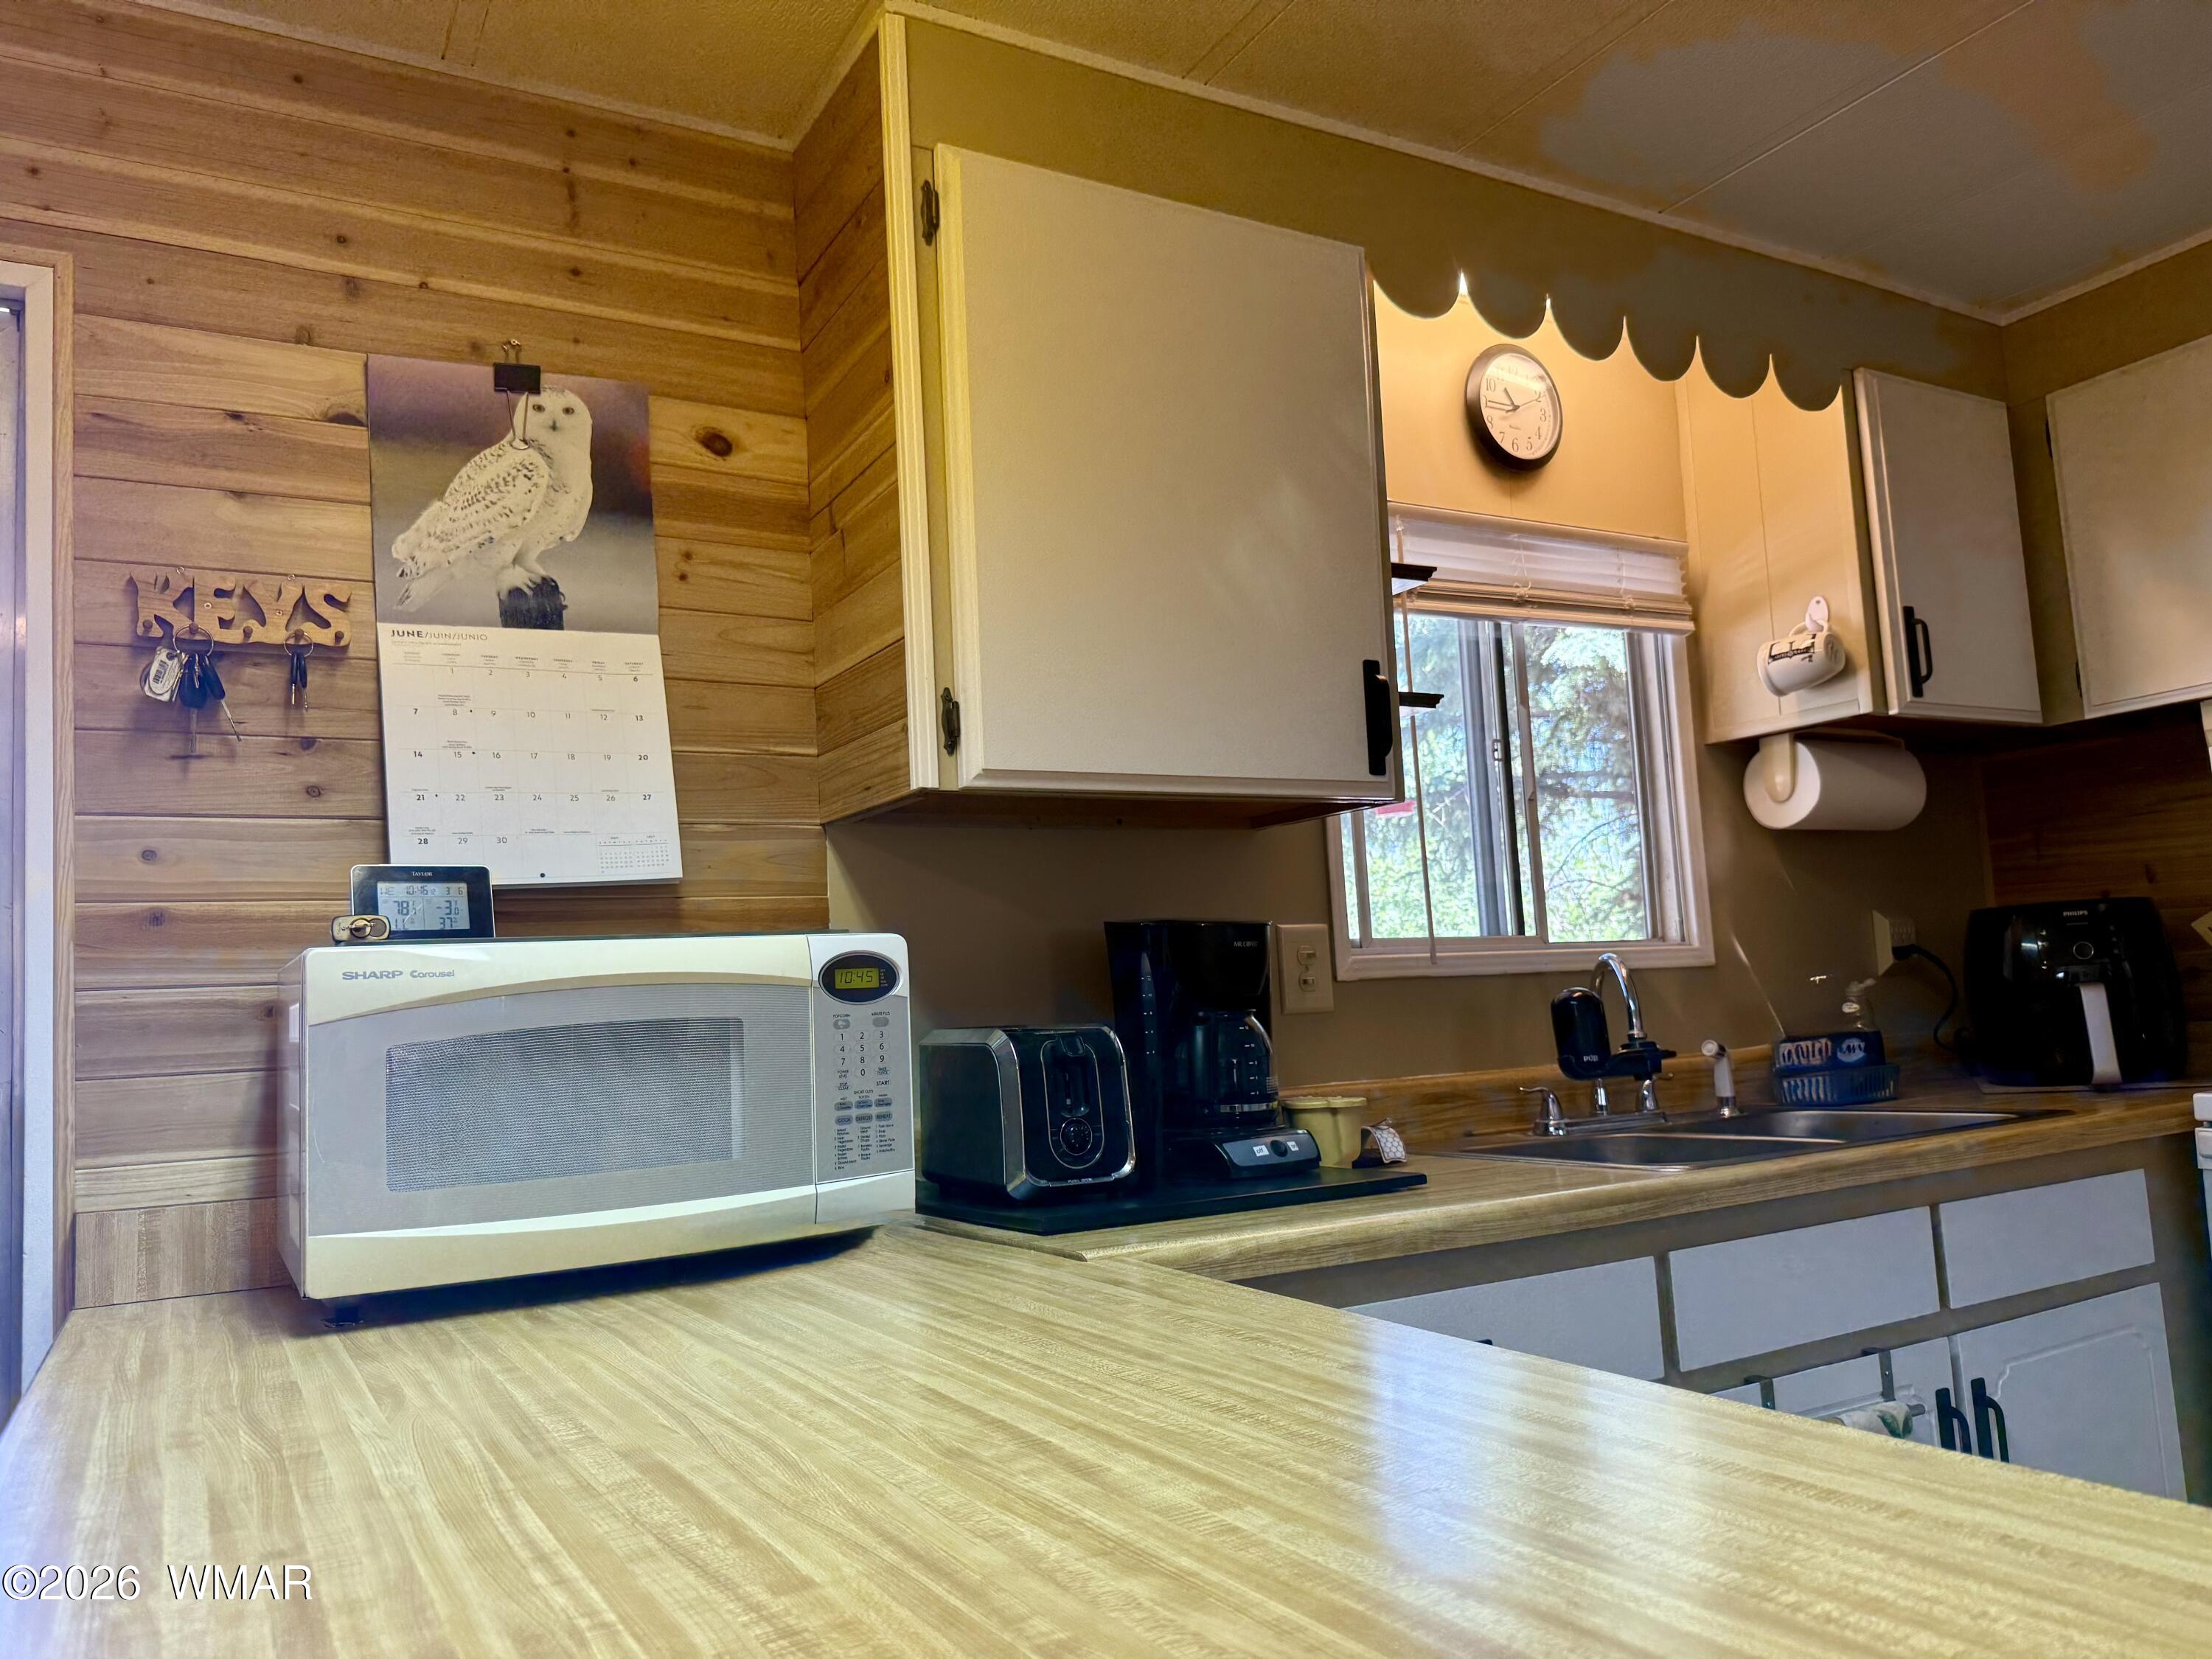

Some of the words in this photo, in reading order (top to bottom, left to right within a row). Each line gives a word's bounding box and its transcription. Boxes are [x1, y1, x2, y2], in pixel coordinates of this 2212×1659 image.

[1486, 378, 1496, 392] 10
[1540, 408, 1546, 422] 3
[1486, 415, 1494, 430] 8
[1499, 431, 1506, 444] 7
[1535, 426, 1542, 440] 4
[1512, 438, 1519, 452] 6
[1526, 437, 1533, 451] 5
[131, 574, 352, 647] KEYS
[497, 836, 507, 844] 30
[445, 887, 451, 895] 3
[458, 887, 463, 895] 6
[342, 970, 403, 980] SHARP
[409, 969, 455, 978] Carousel
[840, 970, 874, 984] 10:45
[860, 1032, 864, 1040] 2
[841, 1057, 846, 1065] 7
[860, 1056, 865, 1064] 8
[860, 1068, 866, 1077] 0
